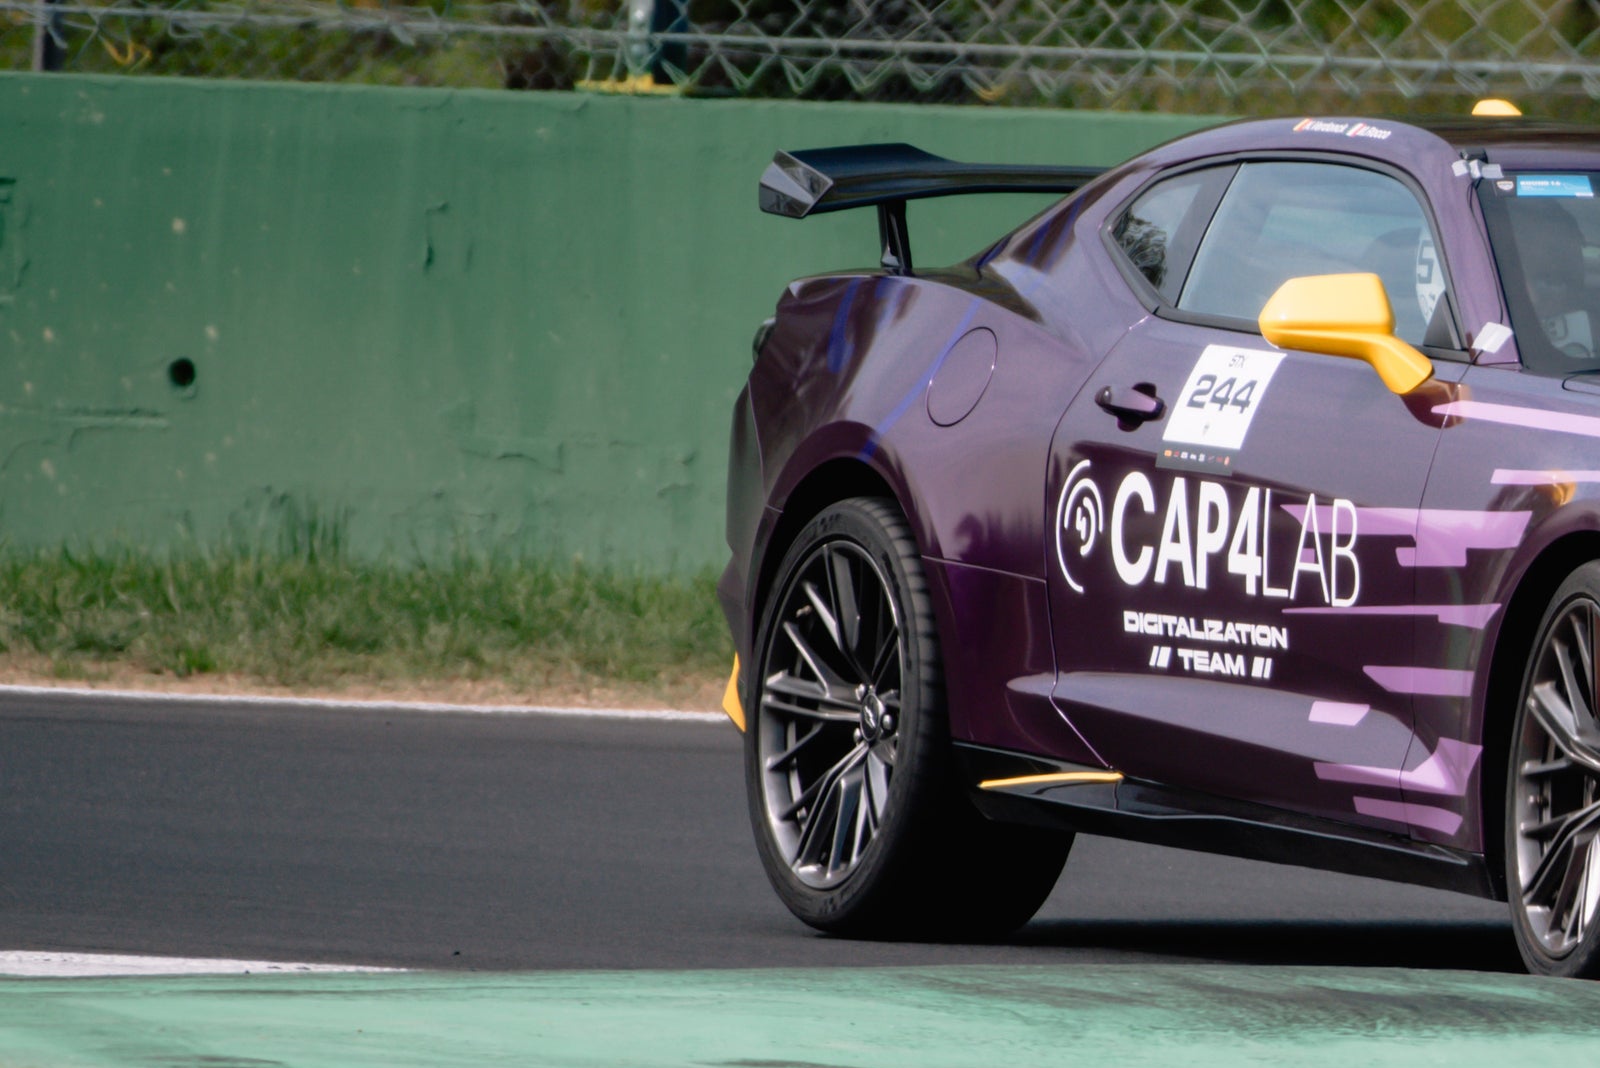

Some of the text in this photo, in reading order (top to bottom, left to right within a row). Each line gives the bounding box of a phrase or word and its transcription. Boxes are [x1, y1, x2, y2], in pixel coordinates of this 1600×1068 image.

[1186, 374, 1258, 414] 244
[1111, 471, 1361, 608] CAP4LAB
[1123, 610, 1289, 650] DIGITALIZATION
[1177, 648, 1246, 677] TEAM
